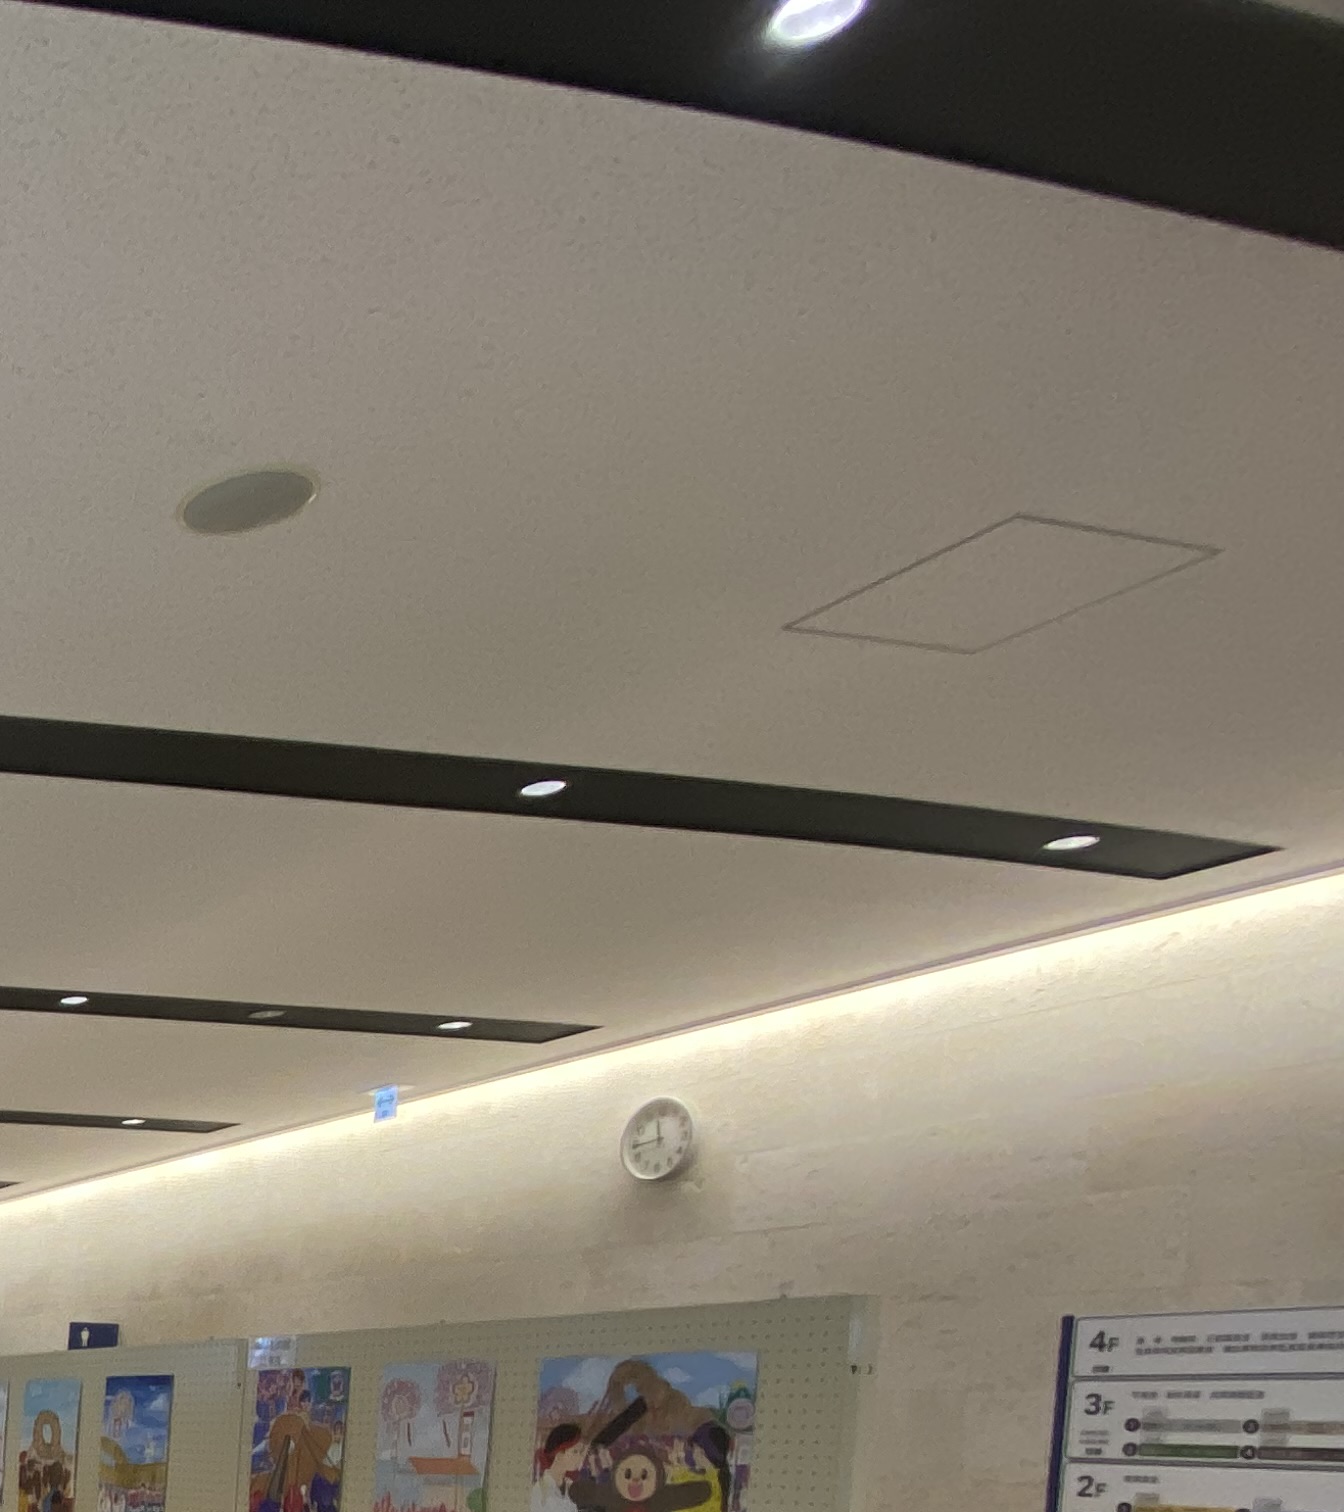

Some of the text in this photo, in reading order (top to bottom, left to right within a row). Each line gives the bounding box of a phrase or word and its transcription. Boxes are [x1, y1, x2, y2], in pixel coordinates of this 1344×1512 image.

[1089, 1331, 1119, 1353] 4F
[1084, 1394, 1115, 1415] 3F
[1076, 1475, 1108, 1497] 2F
